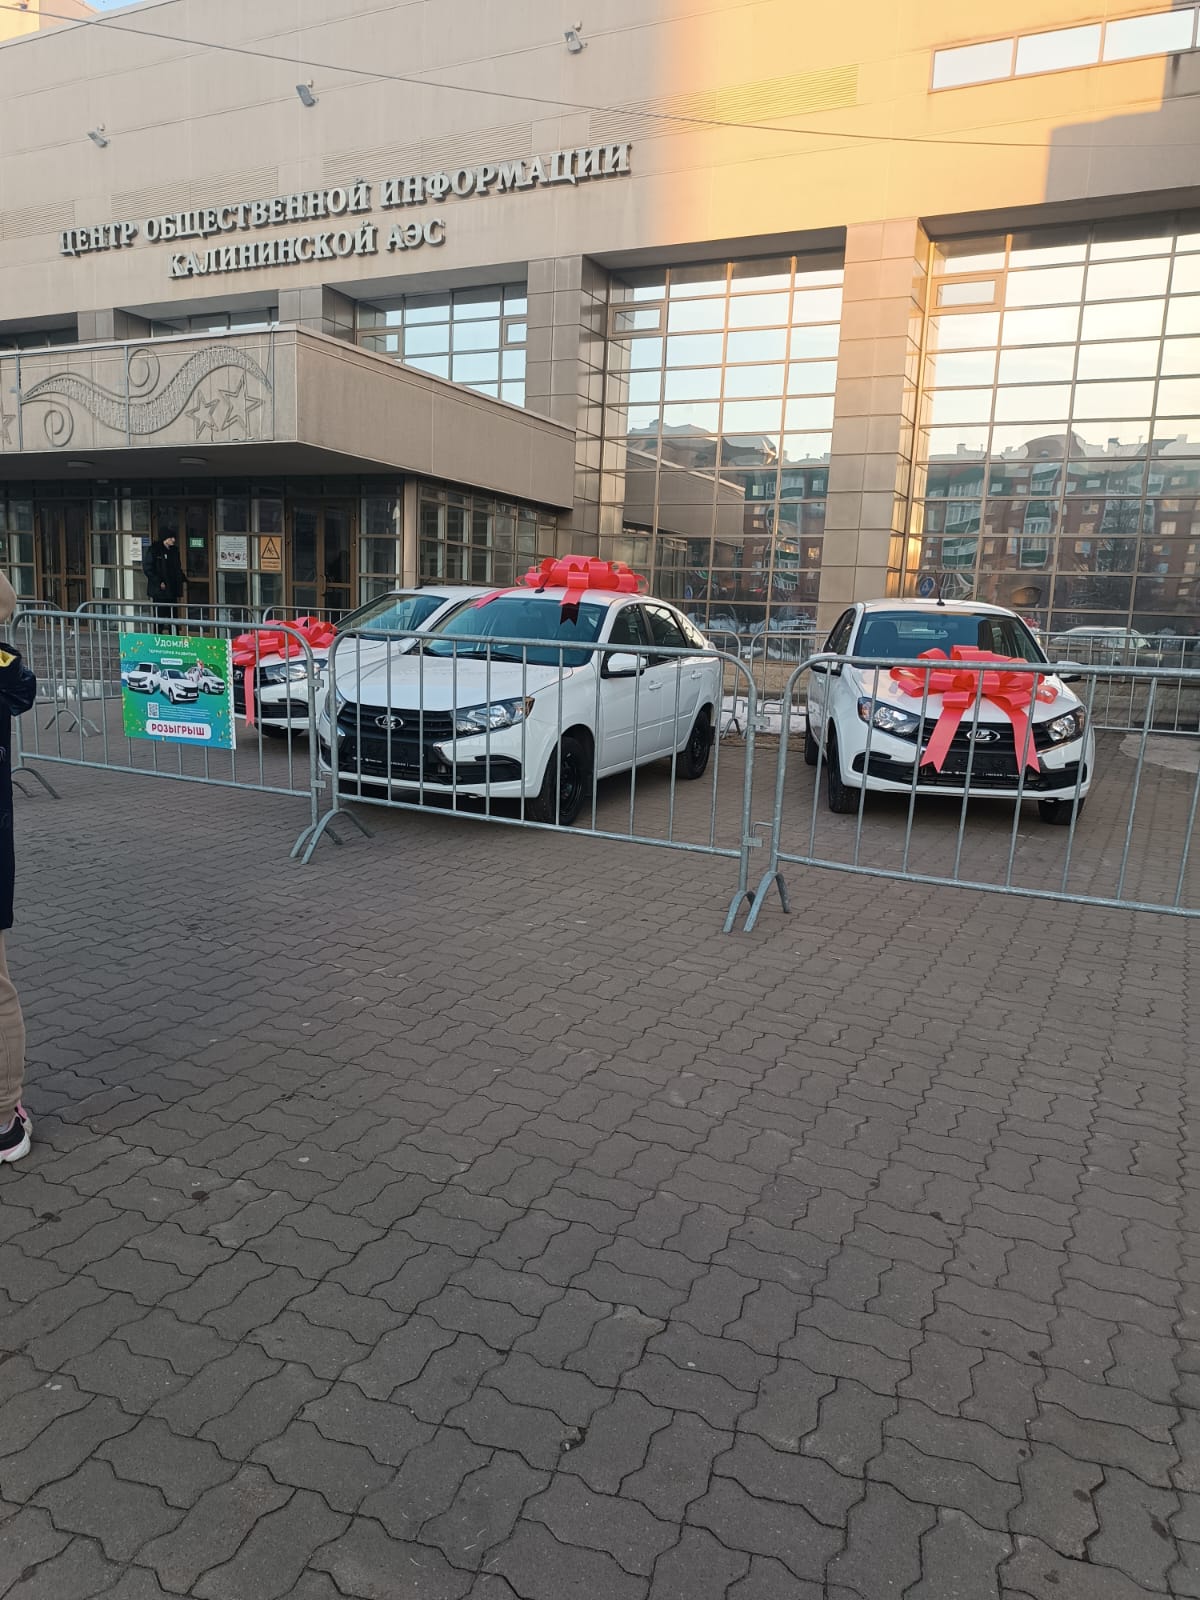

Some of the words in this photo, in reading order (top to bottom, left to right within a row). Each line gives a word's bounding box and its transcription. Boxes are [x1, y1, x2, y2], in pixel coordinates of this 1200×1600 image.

[60, 221, 138, 256] ЦЕНТР
[143, 178, 371, 240] ОБЩЕСТВЕННОЙ
[380, 143, 632, 207] ИНФОРМАЦИИ
[168, 220, 378, 277] КАЛИНИНСКОЙ
[387, 218, 445, 250] АЭС
[154, 637, 189, 648] Удомля
[151, 723, 205, 736] РОЗЫГРЫШ
